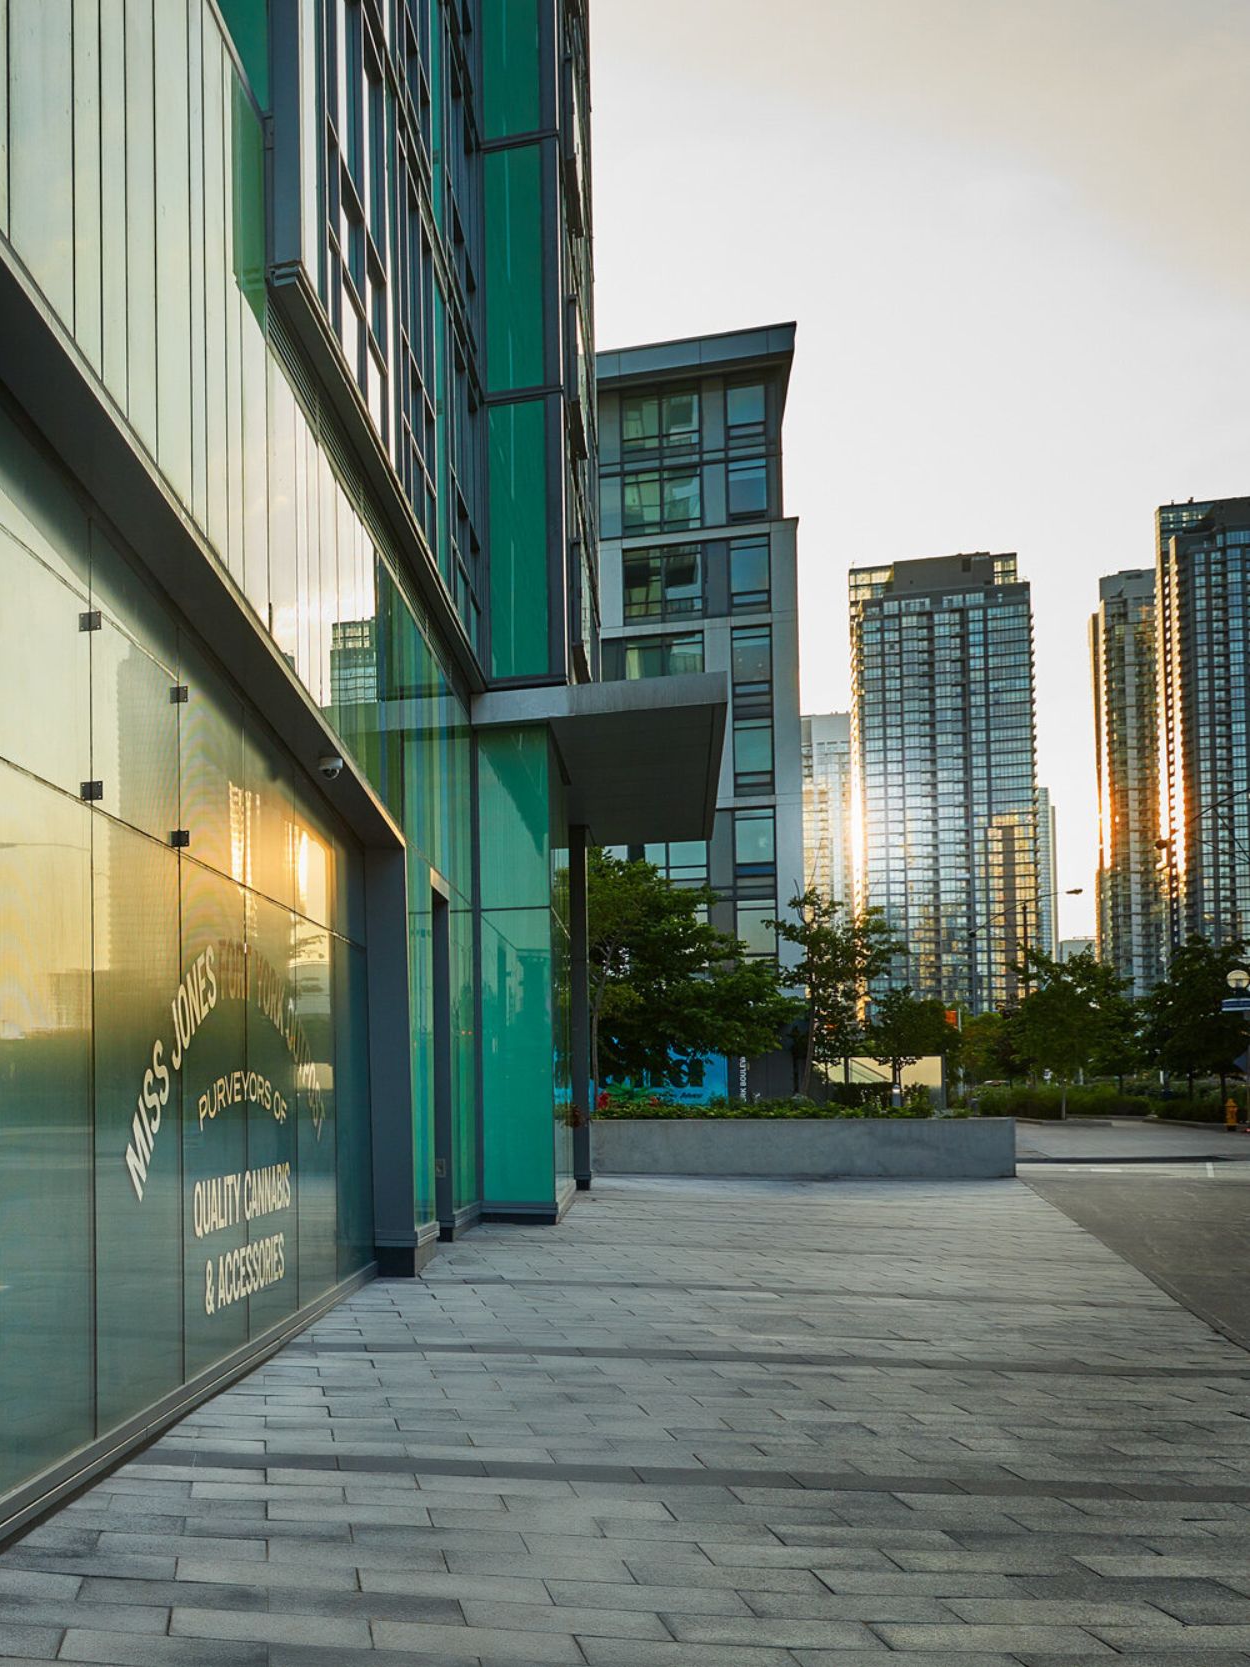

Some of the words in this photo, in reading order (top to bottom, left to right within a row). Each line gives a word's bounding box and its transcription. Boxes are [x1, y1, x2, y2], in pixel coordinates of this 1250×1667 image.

[125, 1039, 170, 1203] MISS
[171, 944, 217, 1070] JONES
[198, 1070, 272, 1132] PURVEYORS
[273, 1096, 288, 1125] OF
[194, 1172, 241, 1240] QUALITY
[244, 1161, 291, 1222] CANNABIS
[205, 1260, 215, 1316] &
[217, 1232, 285, 1309] ACCESSORIES
